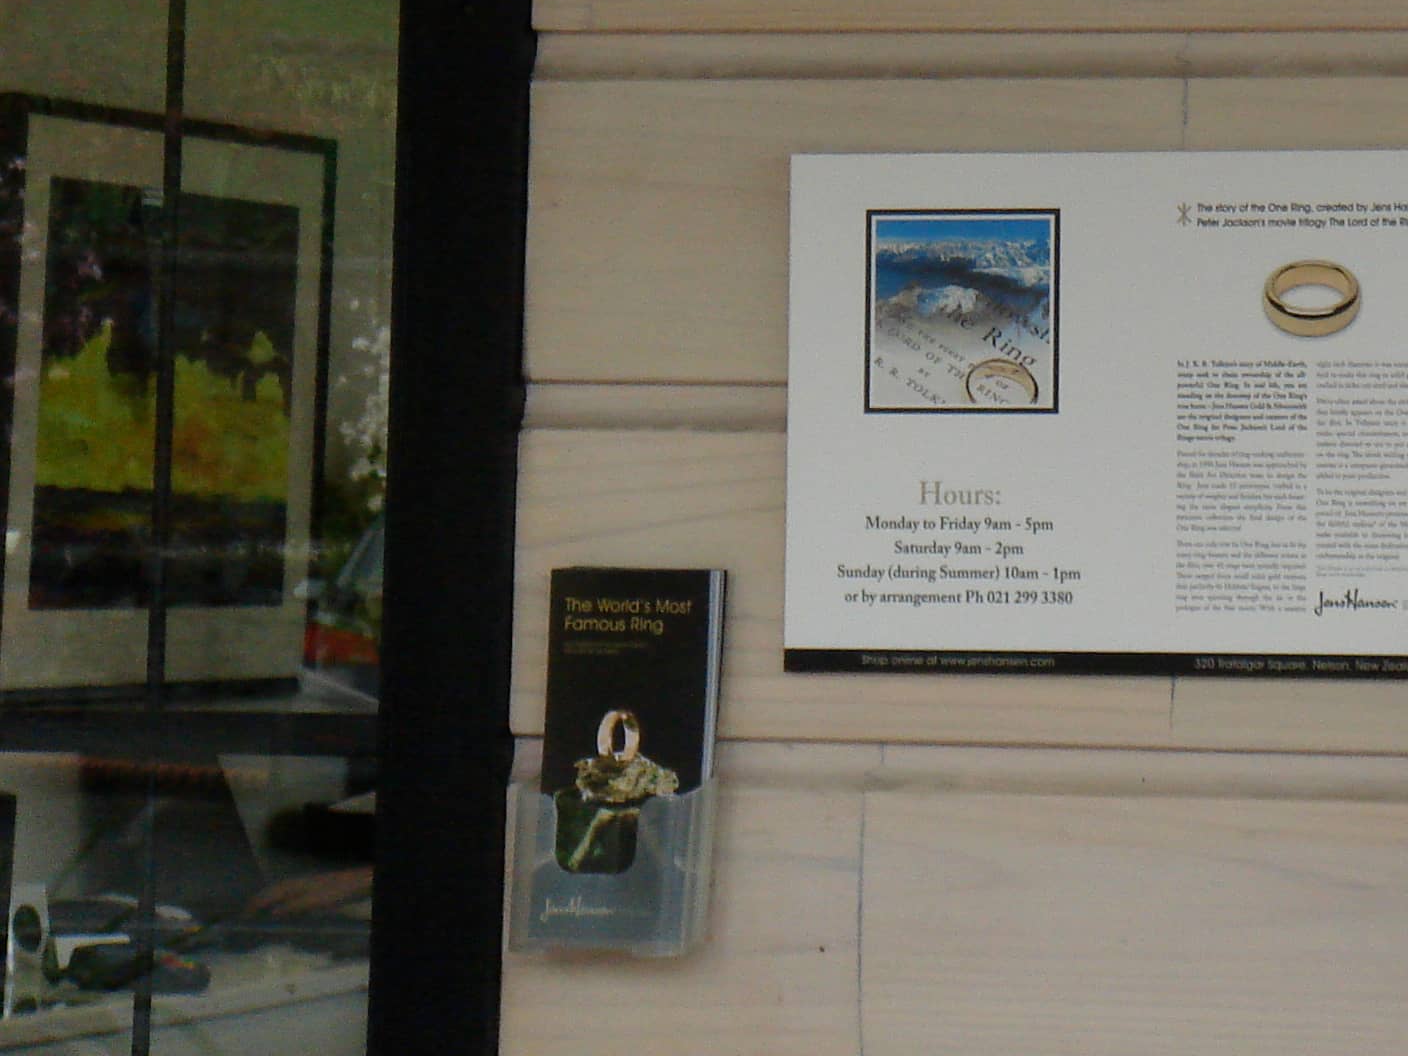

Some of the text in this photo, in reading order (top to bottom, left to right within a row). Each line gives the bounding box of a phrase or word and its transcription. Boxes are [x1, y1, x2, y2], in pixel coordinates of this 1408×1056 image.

[1268, 202, 1288, 213] One
[1348, 216, 1368, 227] Lord
[919, 480, 1001, 506] Hours:
[865, 516, 920, 534] Monday
[923, 518, 936, 531] to
[940, 515, 982, 534] Friday
[984, 517, 1012, 531] 9am
[1024, 516, 1054, 534] 5pm
[894, 540, 952, 559] Saturday
[954, 542, 982, 555] 9am
[995, 542, 1024, 559] 2pm
[837, 565, 886, 583] Sunday
[888, 564, 937, 583] (during
[939, 565, 1000, 582] Summer)
[1004, 566, 1039, 581] 10am
[1053, 566, 1081, 584] 1pm
[565, 597, 692, 614] The World's Most
[844, 589, 1073, 608] or by arrangement Ph 021 299 3380
[564, 616, 664, 635] Famous Ring
